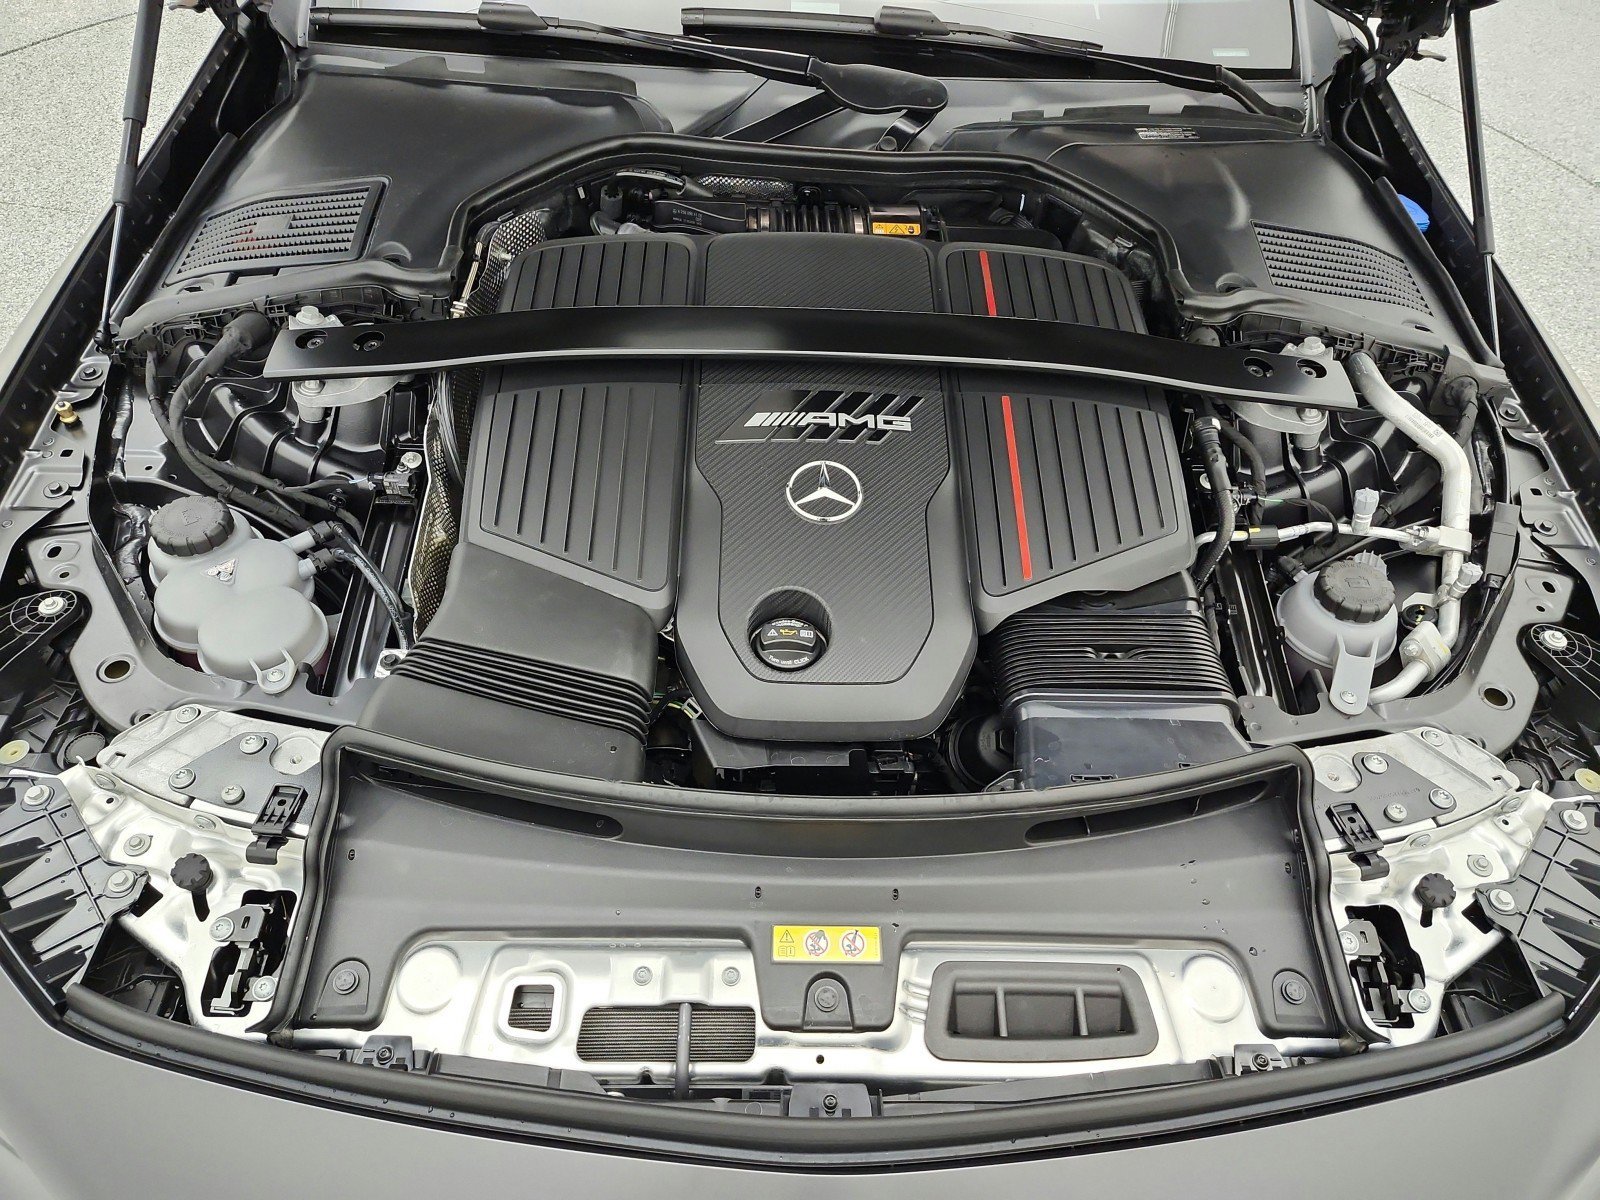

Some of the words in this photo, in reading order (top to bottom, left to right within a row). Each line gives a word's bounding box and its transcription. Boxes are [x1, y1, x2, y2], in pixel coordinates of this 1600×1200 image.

[797, 412, 912, 432] AMG
[769, 655, 780, 664] Turn
[794, 656, 810, 664] CLICK
